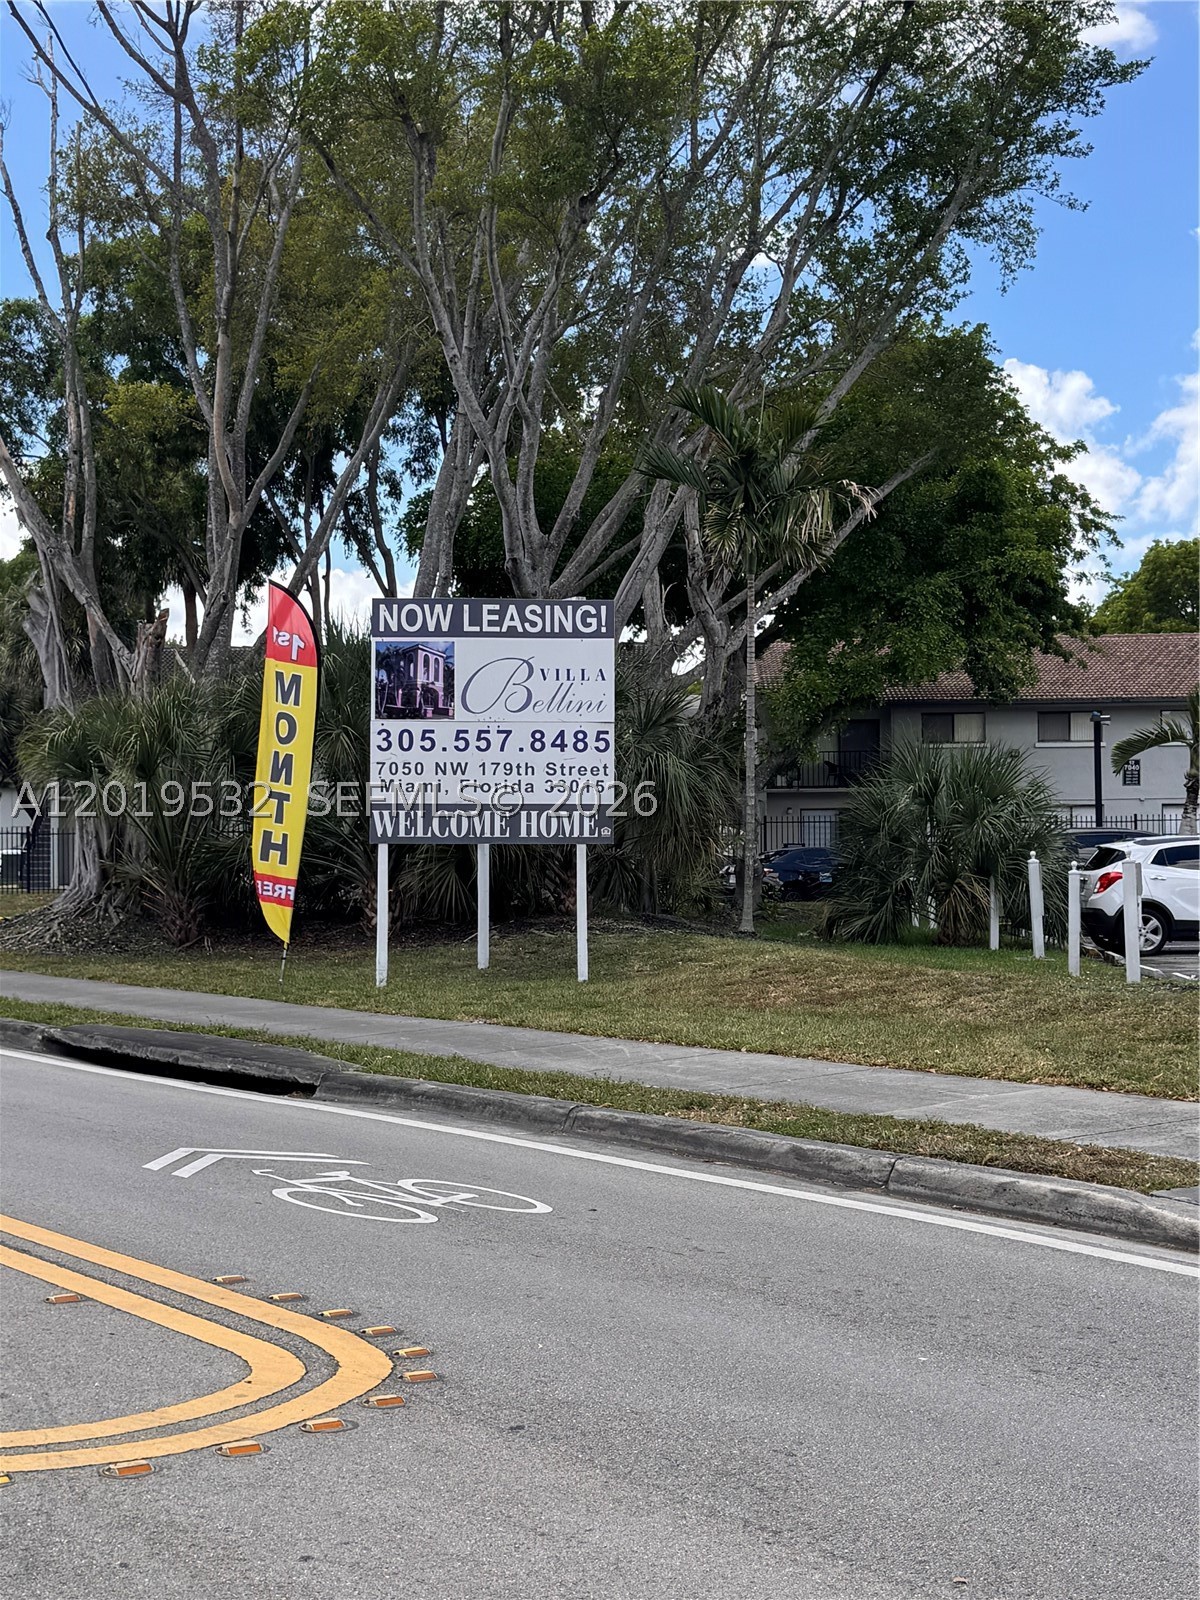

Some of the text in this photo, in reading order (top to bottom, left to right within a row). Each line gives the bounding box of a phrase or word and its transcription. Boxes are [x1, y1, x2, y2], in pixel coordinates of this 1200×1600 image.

[378, 603, 607, 633] NOW LEASING!
[460, 655, 608, 715] Bellini
[539, 667, 608, 682] VILLA
[376, 728, 611, 753] 305.557.8485
[376, 761, 610, 776] 7050 NW 179th Street
[379, 778, 605, 796] Miami, Florida 33015
[372, 809, 600, 838] WELCOME HOME
